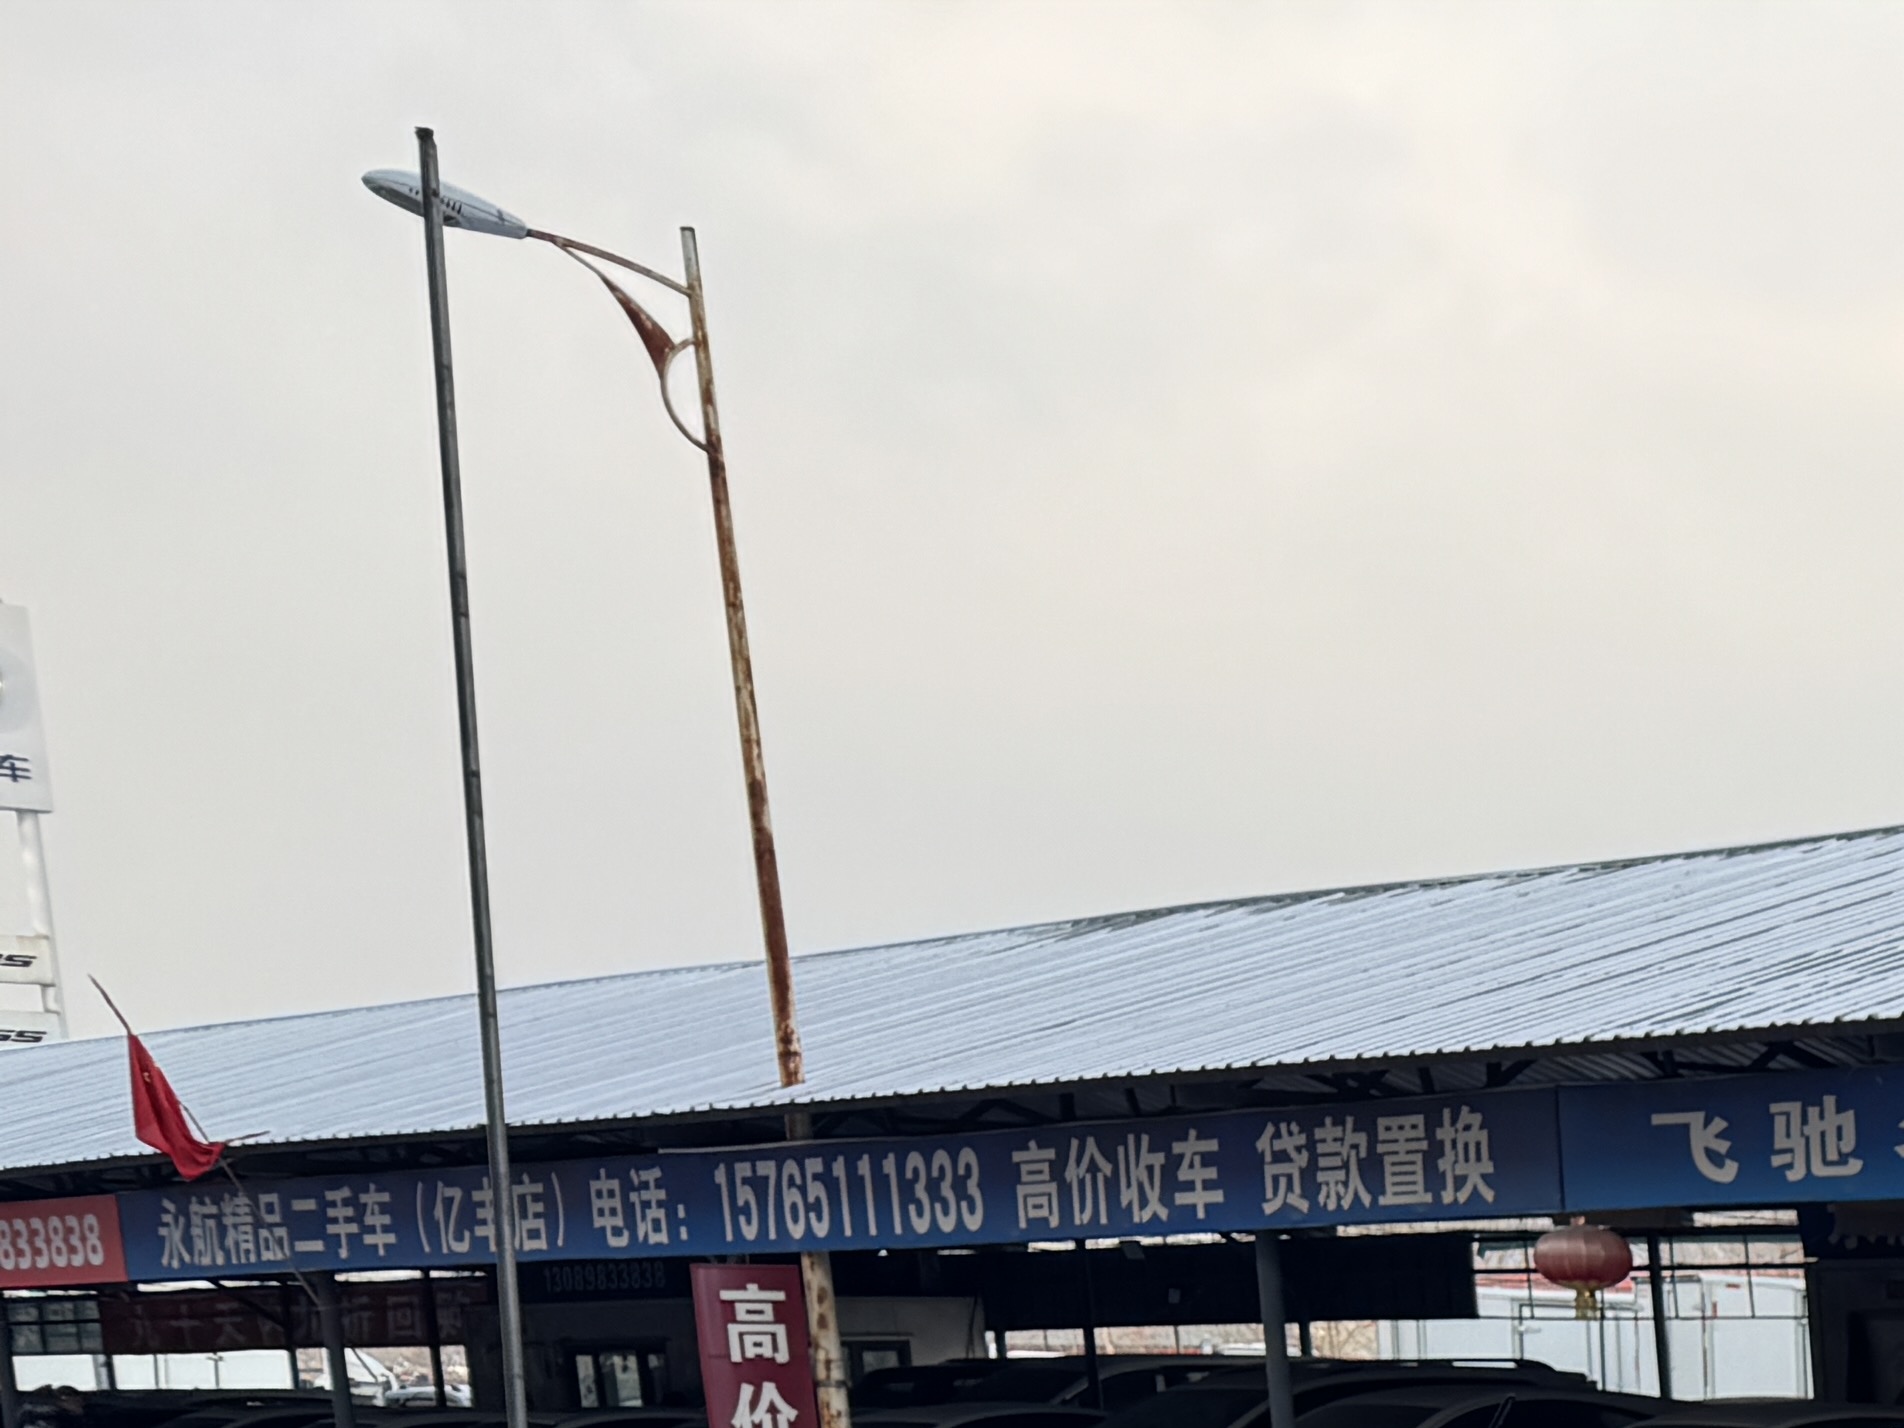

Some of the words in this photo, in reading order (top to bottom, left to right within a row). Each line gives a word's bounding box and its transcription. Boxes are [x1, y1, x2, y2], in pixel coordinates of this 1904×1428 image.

[714, 1147, 984, 1242] 15765111333
[1012, 1129, 1225, 1230] 高价收车
[1256, 1105, 1496, 1217] 贷款置换
